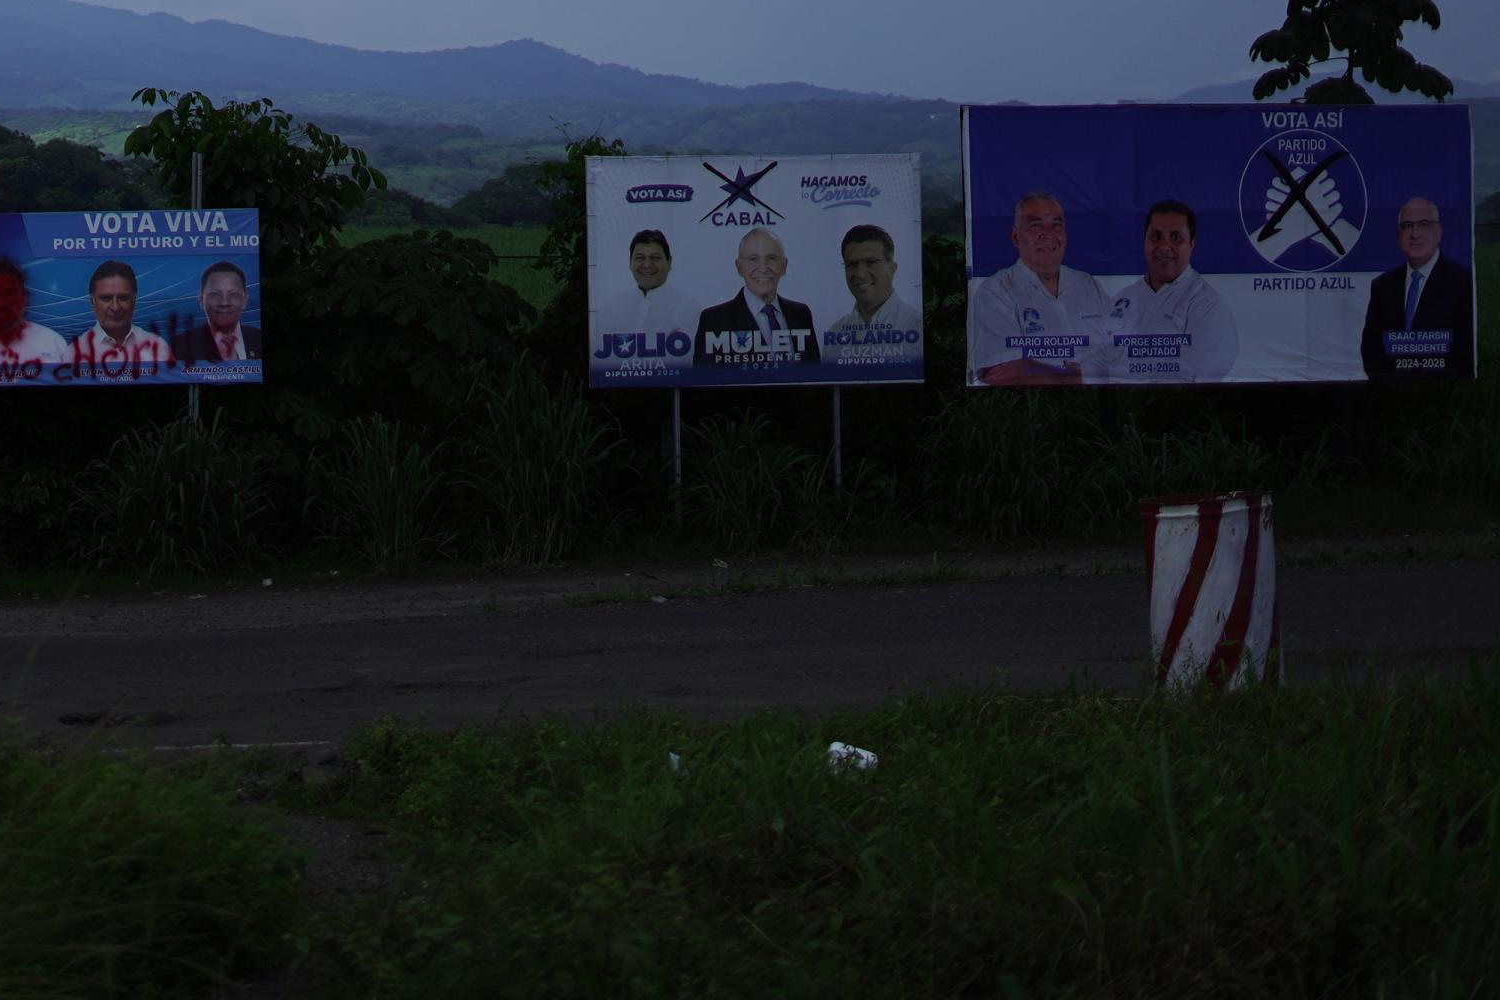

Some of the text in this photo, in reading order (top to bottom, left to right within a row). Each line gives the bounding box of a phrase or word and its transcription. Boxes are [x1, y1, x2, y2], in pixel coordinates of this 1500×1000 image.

[1261, 108, 1344, 128] VOTA ASÍ
[1278, 139, 1327, 151] PARTIDO
[1287, 153, 1317, 165] AZUL
[801, 175, 868, 188] HAGAMOS
[629, 189, 664, 200] VOTA
[810, 183, 881, 203] Correcto
[84, 211, 229, 234] VOTA VIVA
[711, 212, 777, 226] CABAL
[53, 235, 260, 250] POR TU FUTURO Y EL MIO
[1253, 277, 1355, 291] PARTIDO AZUL
[841, 323, 893, 331] INGENIERO
[704, 328, 811, 355] MULET
[823, 329, 920, 346] ROLANDO
[1010, 336, 1083, 346] MARIO ROLDAN
[1119, 336, 1189, 346] JORGE SEGURA
[1388, 331, 1450, 340] ISAAC FARSHI
[594, 331, 692, 359] JULIO
[1391, 344, 1447, 352] PRESIDENTE
[715, 352, 802, 364] PRESIDENTE
[1027, 348, 1071, 357] ALCALDE
[1132, 348, 1177, 356] DIPUTADO
[620, 358, 667, 370] ARITA
[1129, 363, 1180, 373] 2024-2028
[1396, 359, 1445, 368] 2024-2028
